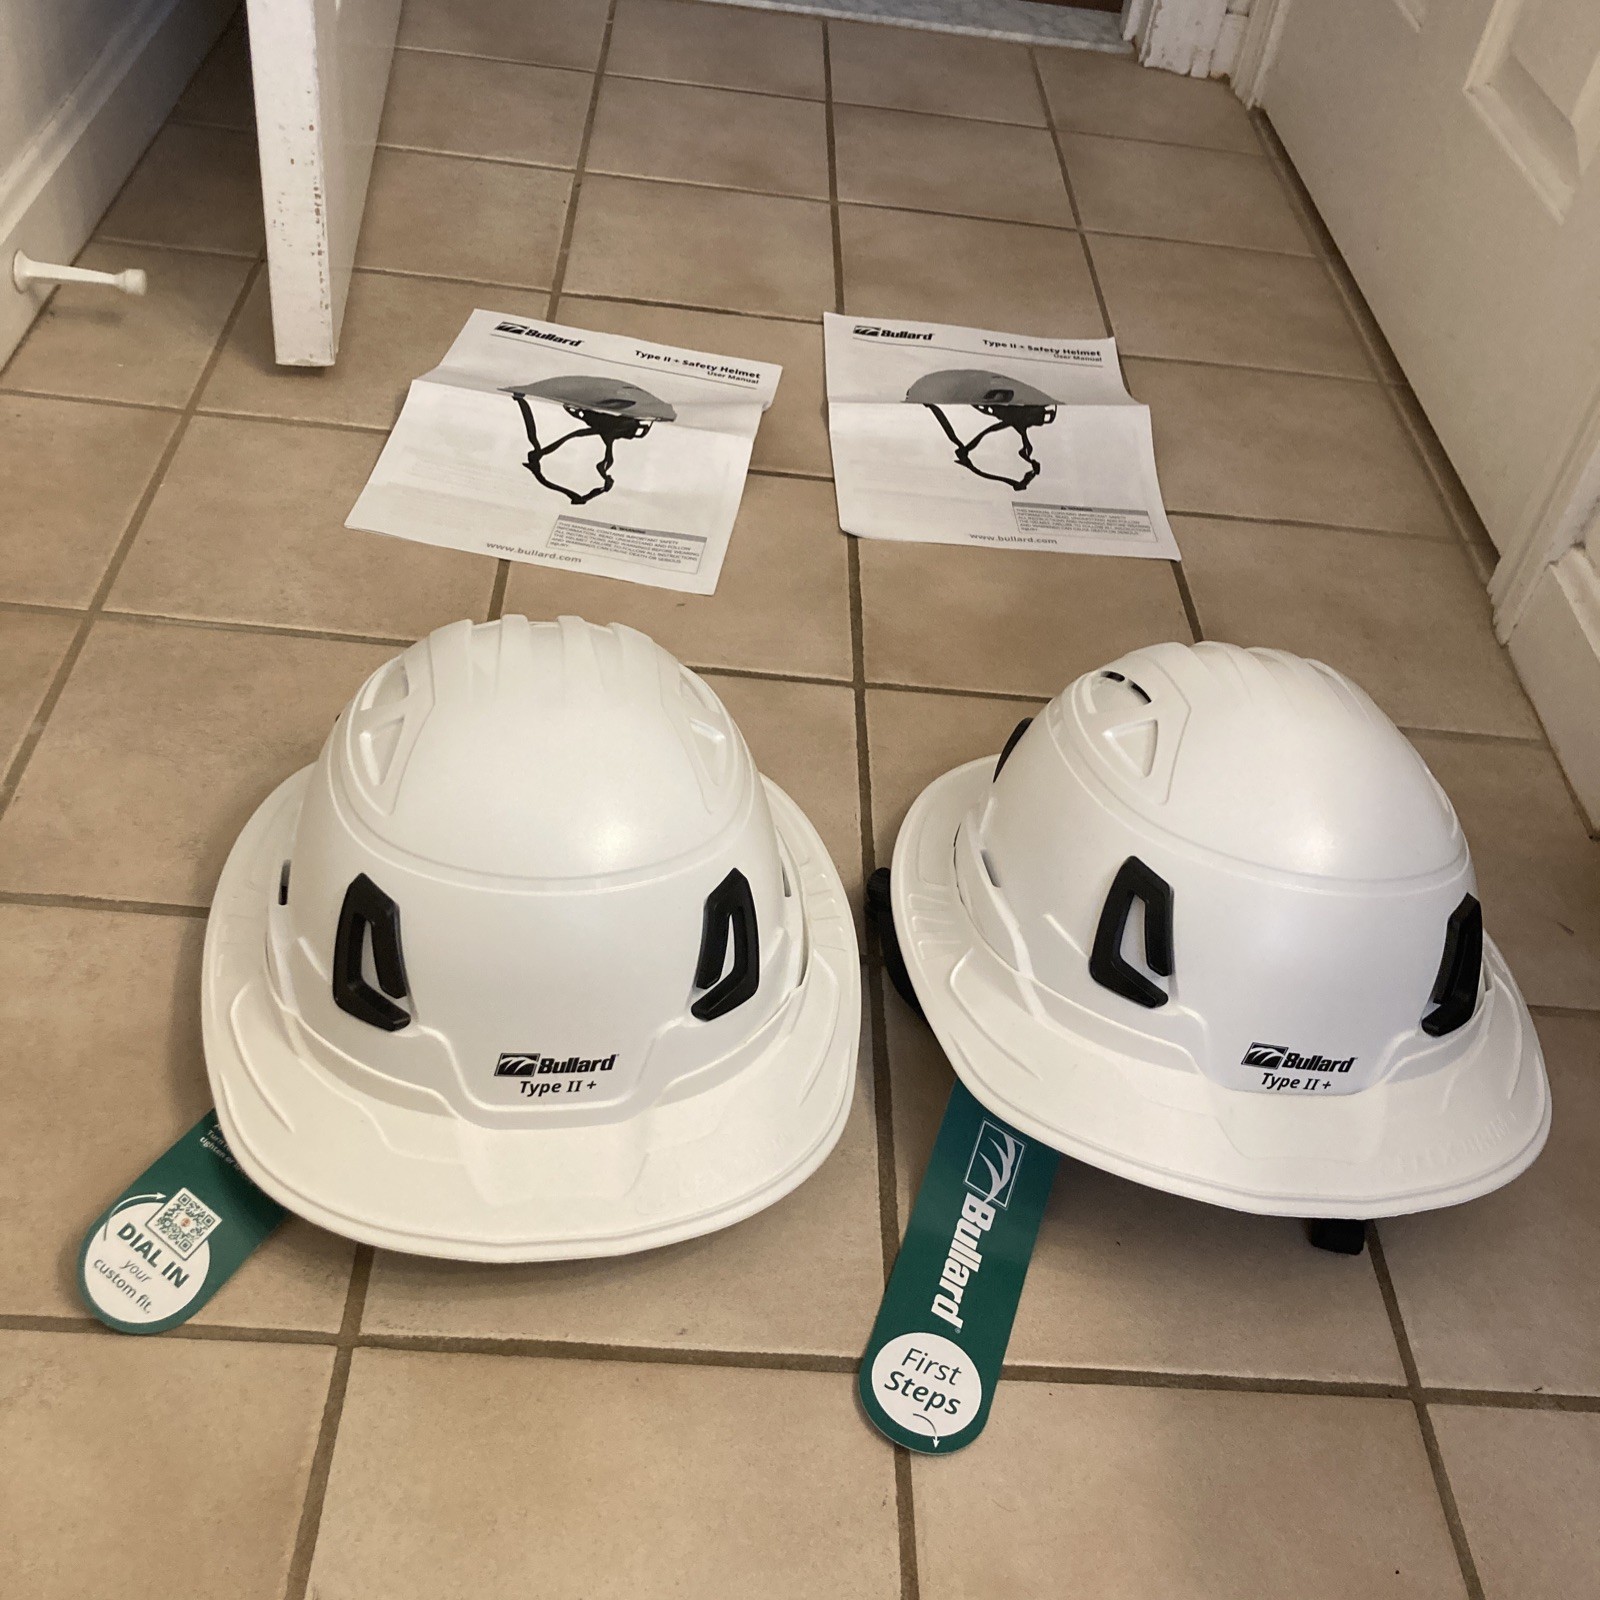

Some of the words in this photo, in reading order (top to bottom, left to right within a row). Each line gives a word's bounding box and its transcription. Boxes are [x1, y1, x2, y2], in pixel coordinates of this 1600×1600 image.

[525, 329, 582, 347] Bullard
[880, 330, 933, 341] Bullard
[982, 339, 1007, 348] Type
[1027, 345, 1060, 354] Safety
[1062, 349, 1101, 357] Helmet
[635, 350, 661, 360] Type
[682, 360, 718, 371] Safety
[720, 366, 761, 379] Helmet
[707, 370, 726, 379] User
[728, 374, 759, 385] Manual
[970, 533, 1058, 545] www.bullard.com
[486, 542, 582, 563] www.bullard.com
[537, 1054, 617, 1074] Bullard
[1282, 1052, 1355, 1073] Bullard
[520, 1080, 562, 1097] Type
[566, 1080, 583, 1092] II
[1261, 1072, 1300, 1091] Type
[1303, 1078, 1320, 1090] II
[117, 1222, 159, 1268] DIAL
[161, 1261, 190, 1289] IN
[930, 1192, 997, 1330] Bullard
[93, 1259, 137, 1299] custom
[120, 1258, 152, 1283] your
[901, 1347, 962, 1386] First
[884, 1371, 961, 1415] Steps
